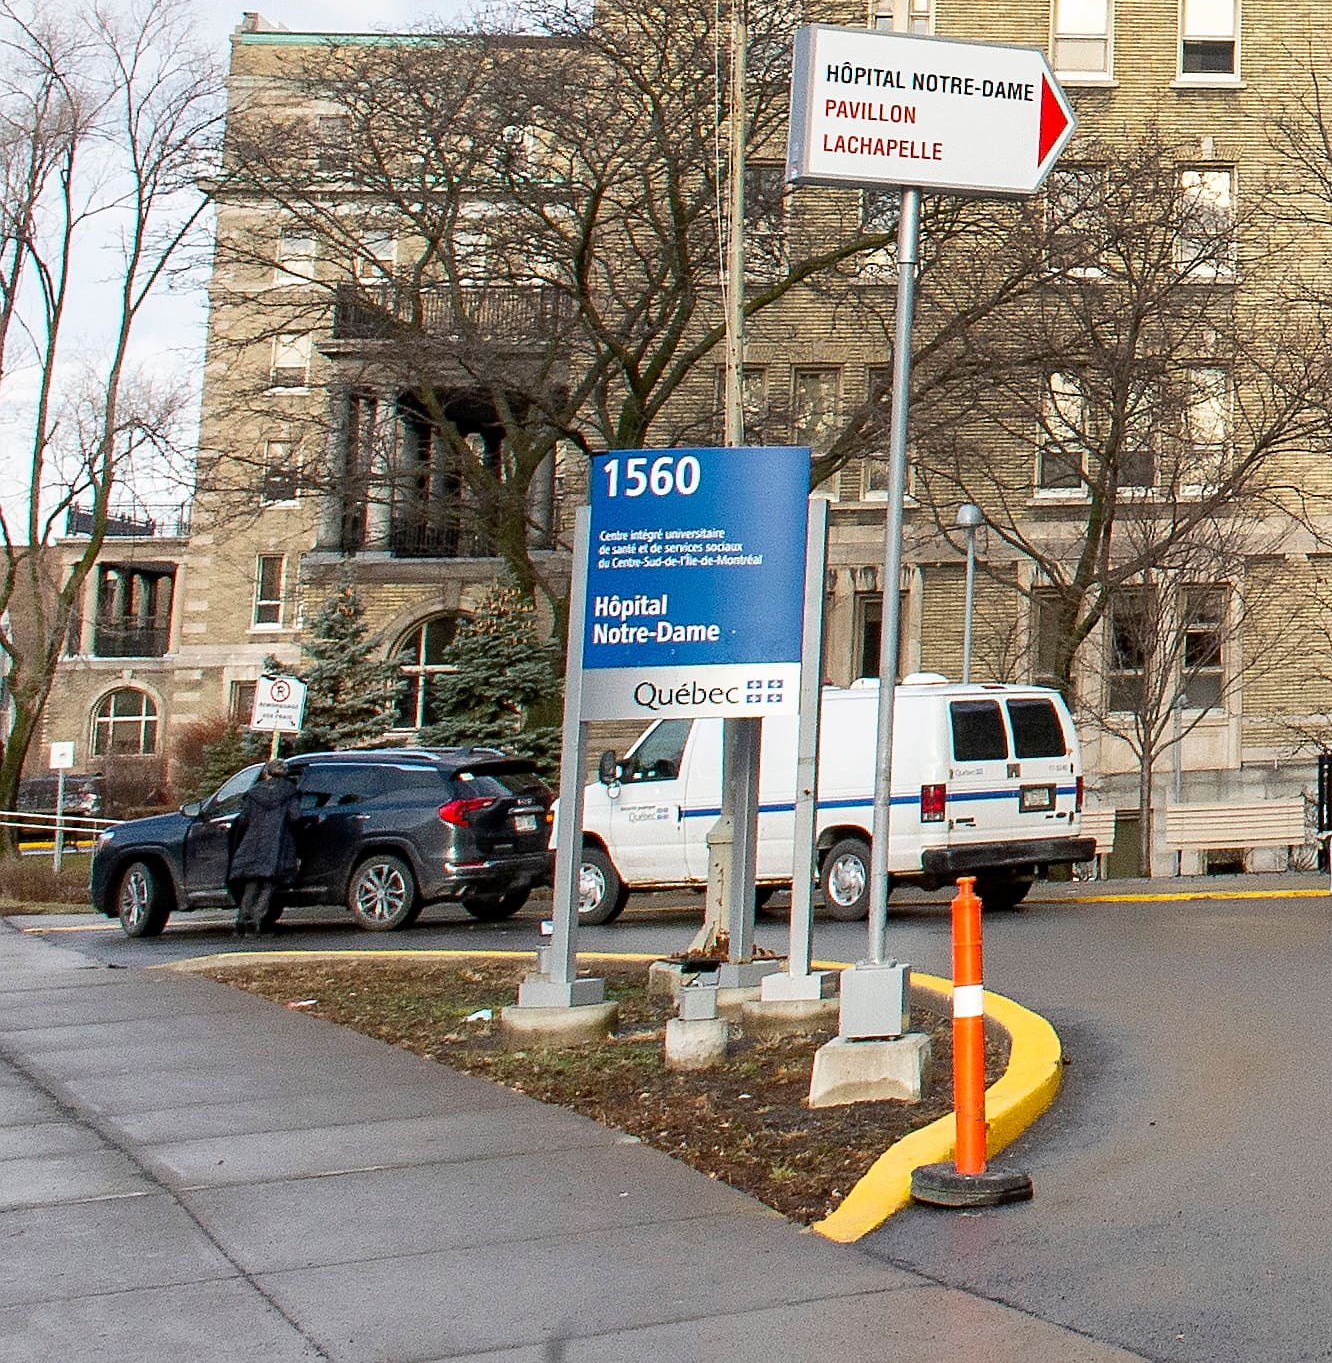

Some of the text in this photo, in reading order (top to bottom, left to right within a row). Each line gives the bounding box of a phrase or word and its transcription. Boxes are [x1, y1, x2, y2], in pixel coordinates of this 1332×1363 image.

[826, 61, 1035, 102] HÔPITAL NOTRE-DAME
[825, 99, 916, 124] PAVILLON
[823, 134, 943, 161] LACHAPELLE
[604, 455, 701, 498] 1560
[599, 528, 726, 542] Centre intégré universitaire
[599, 541, 743, 555] de santé et de services sociaux
[598, 557, 610, 569] du
[594, 594, 667, 621] Hôpital
[593, 620, 720, 645] Notre-Dame
[634, 680, 740, 711] Québec
